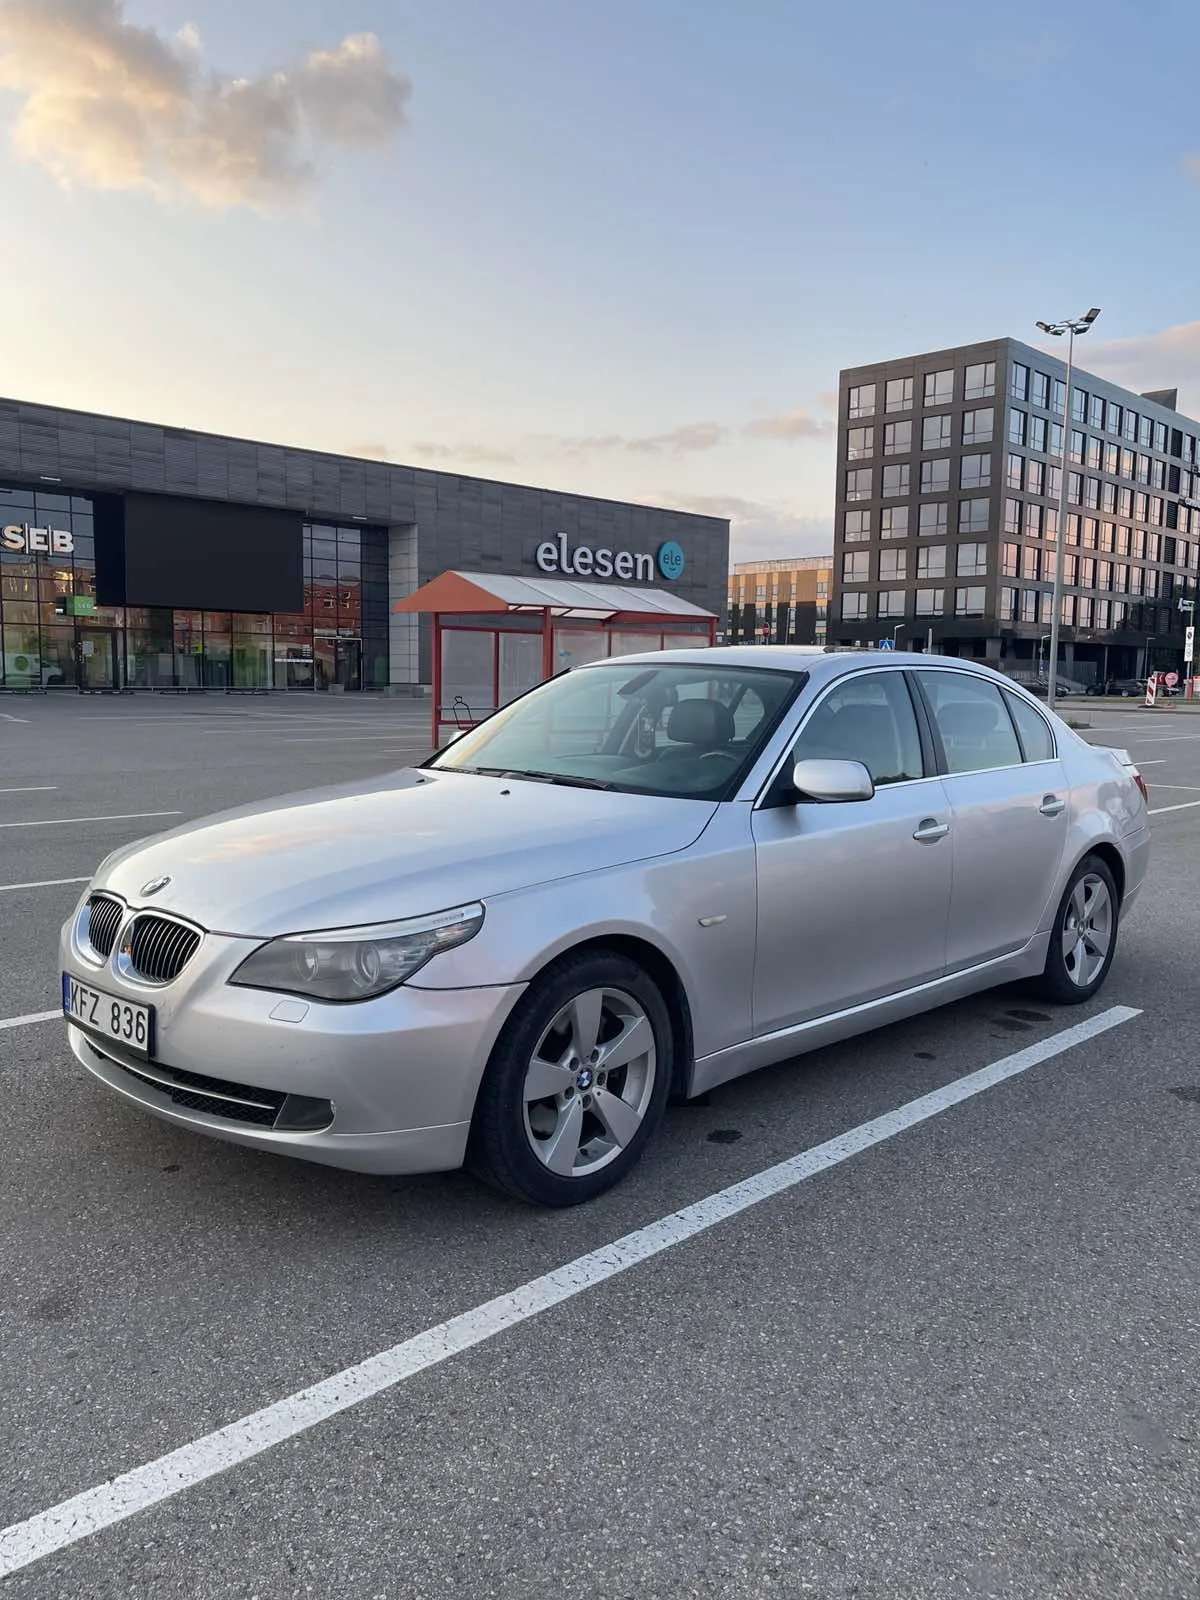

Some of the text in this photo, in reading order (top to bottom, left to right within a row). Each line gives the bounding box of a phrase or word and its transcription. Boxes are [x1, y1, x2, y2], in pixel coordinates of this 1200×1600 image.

[536, 532, 654, 581] elesen
[663, 550, 681, 566] ele
[71, 981, 146, 1044] KFZ 836
